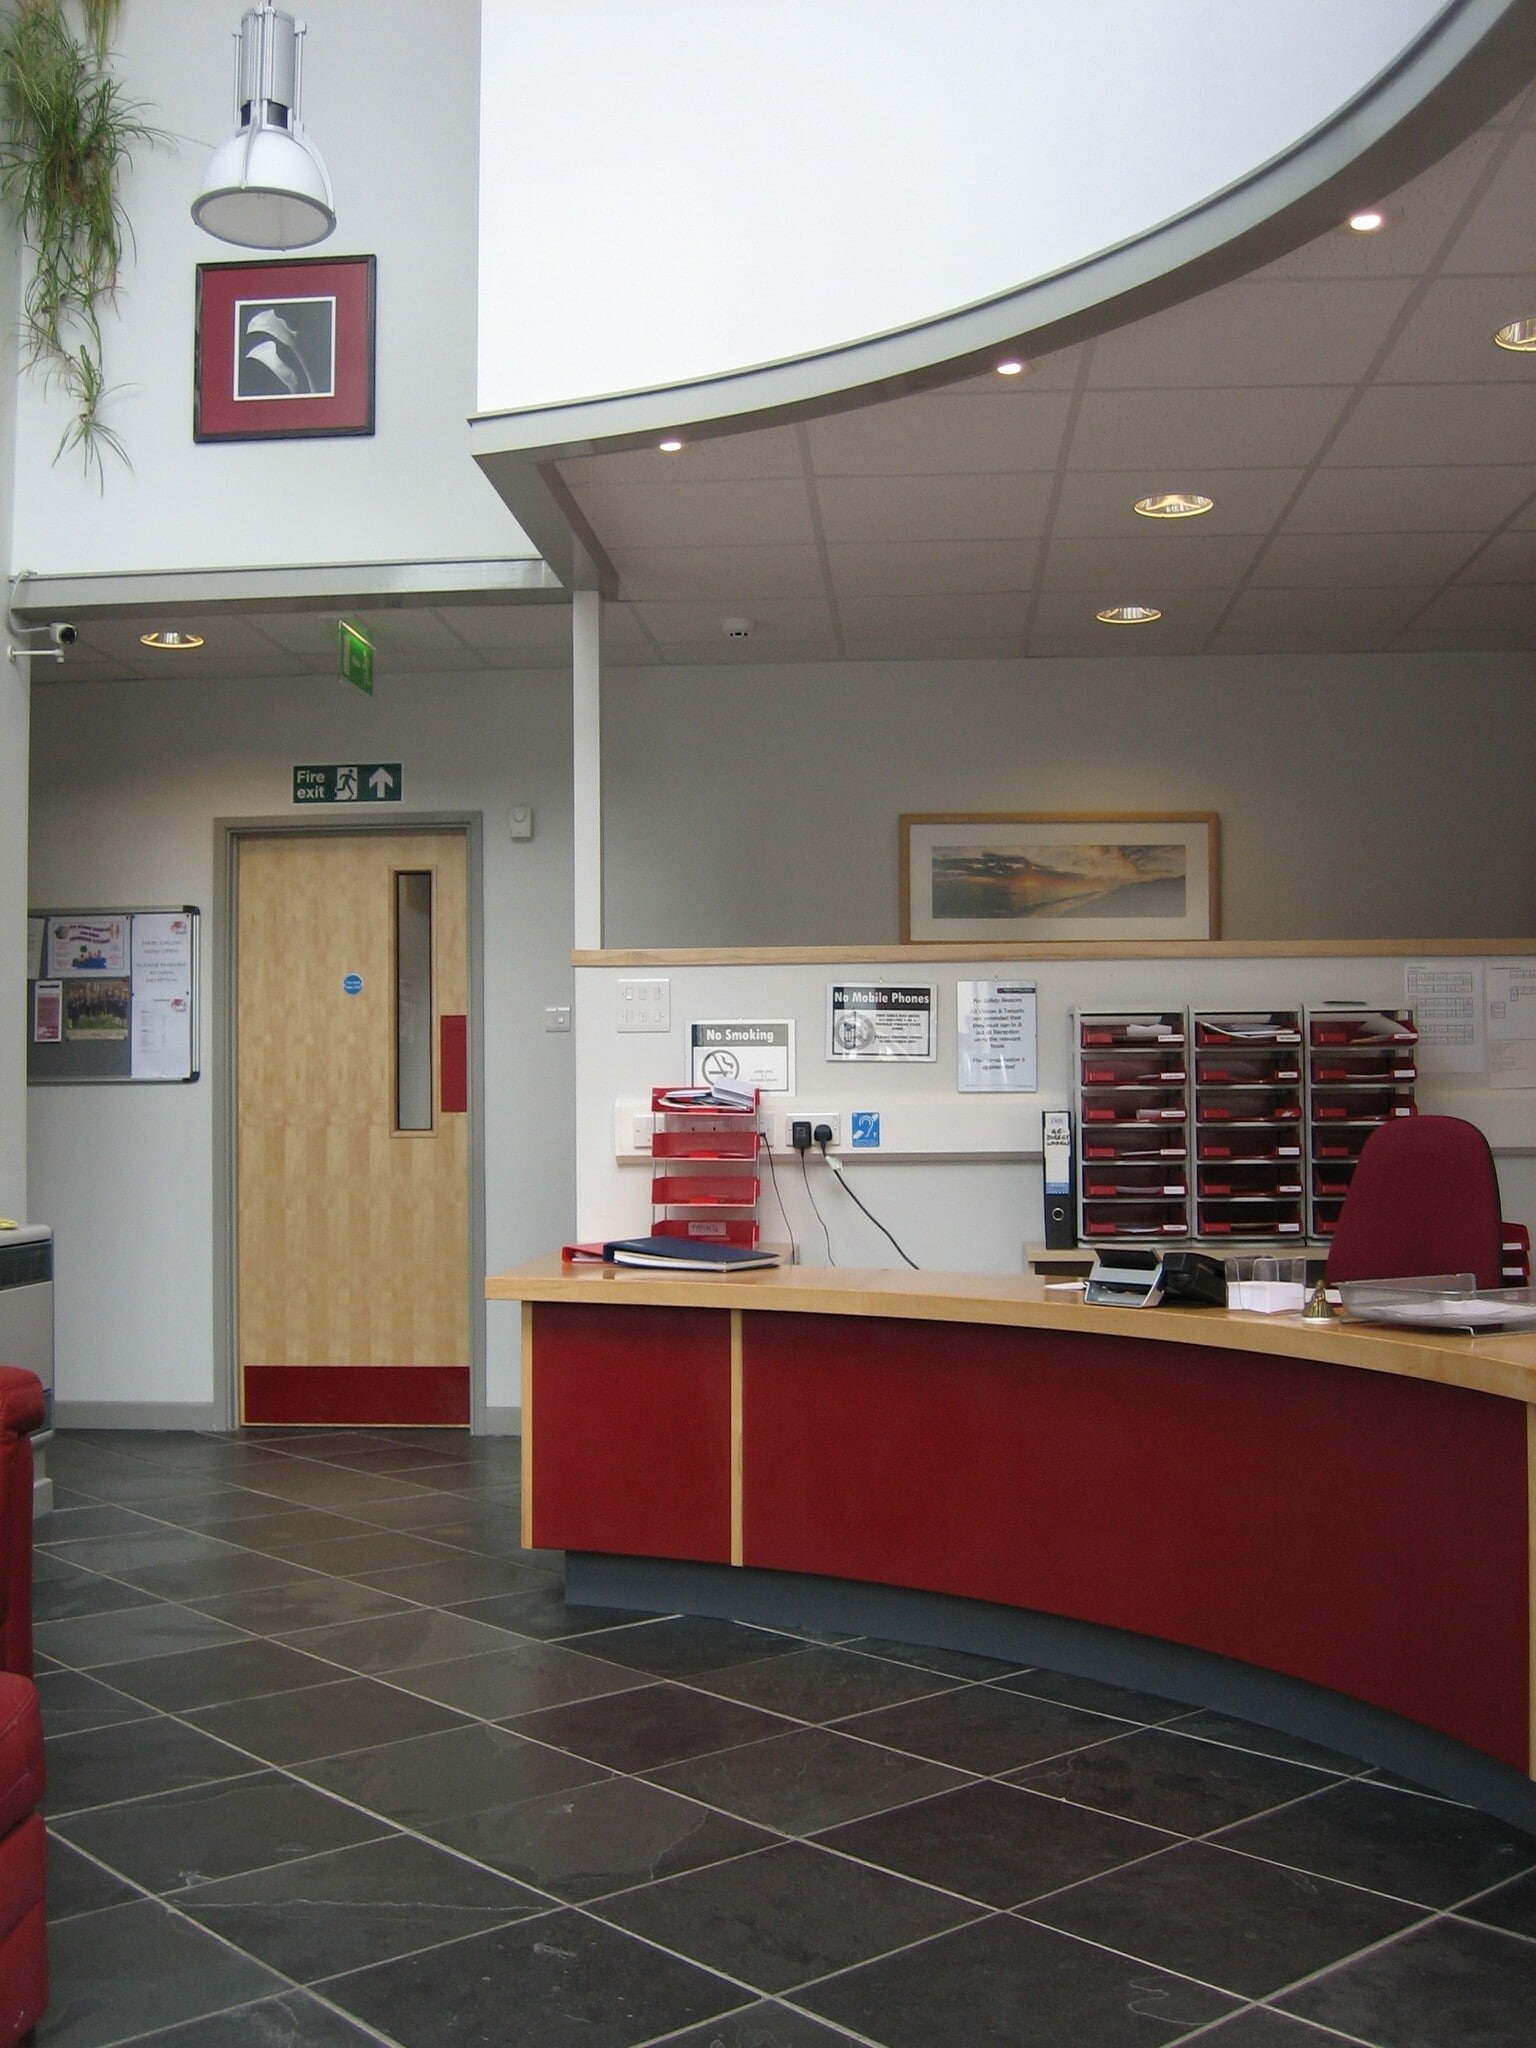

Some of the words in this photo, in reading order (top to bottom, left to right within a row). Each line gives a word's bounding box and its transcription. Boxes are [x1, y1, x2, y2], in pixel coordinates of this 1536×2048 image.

[297, 770, 325, 783] Fire
[297, 785, 325, 799] exit
[834, 991, 849, 1003] No
[852, 991, 889, 1004] Mobile
[892, 992, 930, 1004] Phones
[706, 1029, 722, 1041] No
[725, 1028, 774, 1043] Smoking
